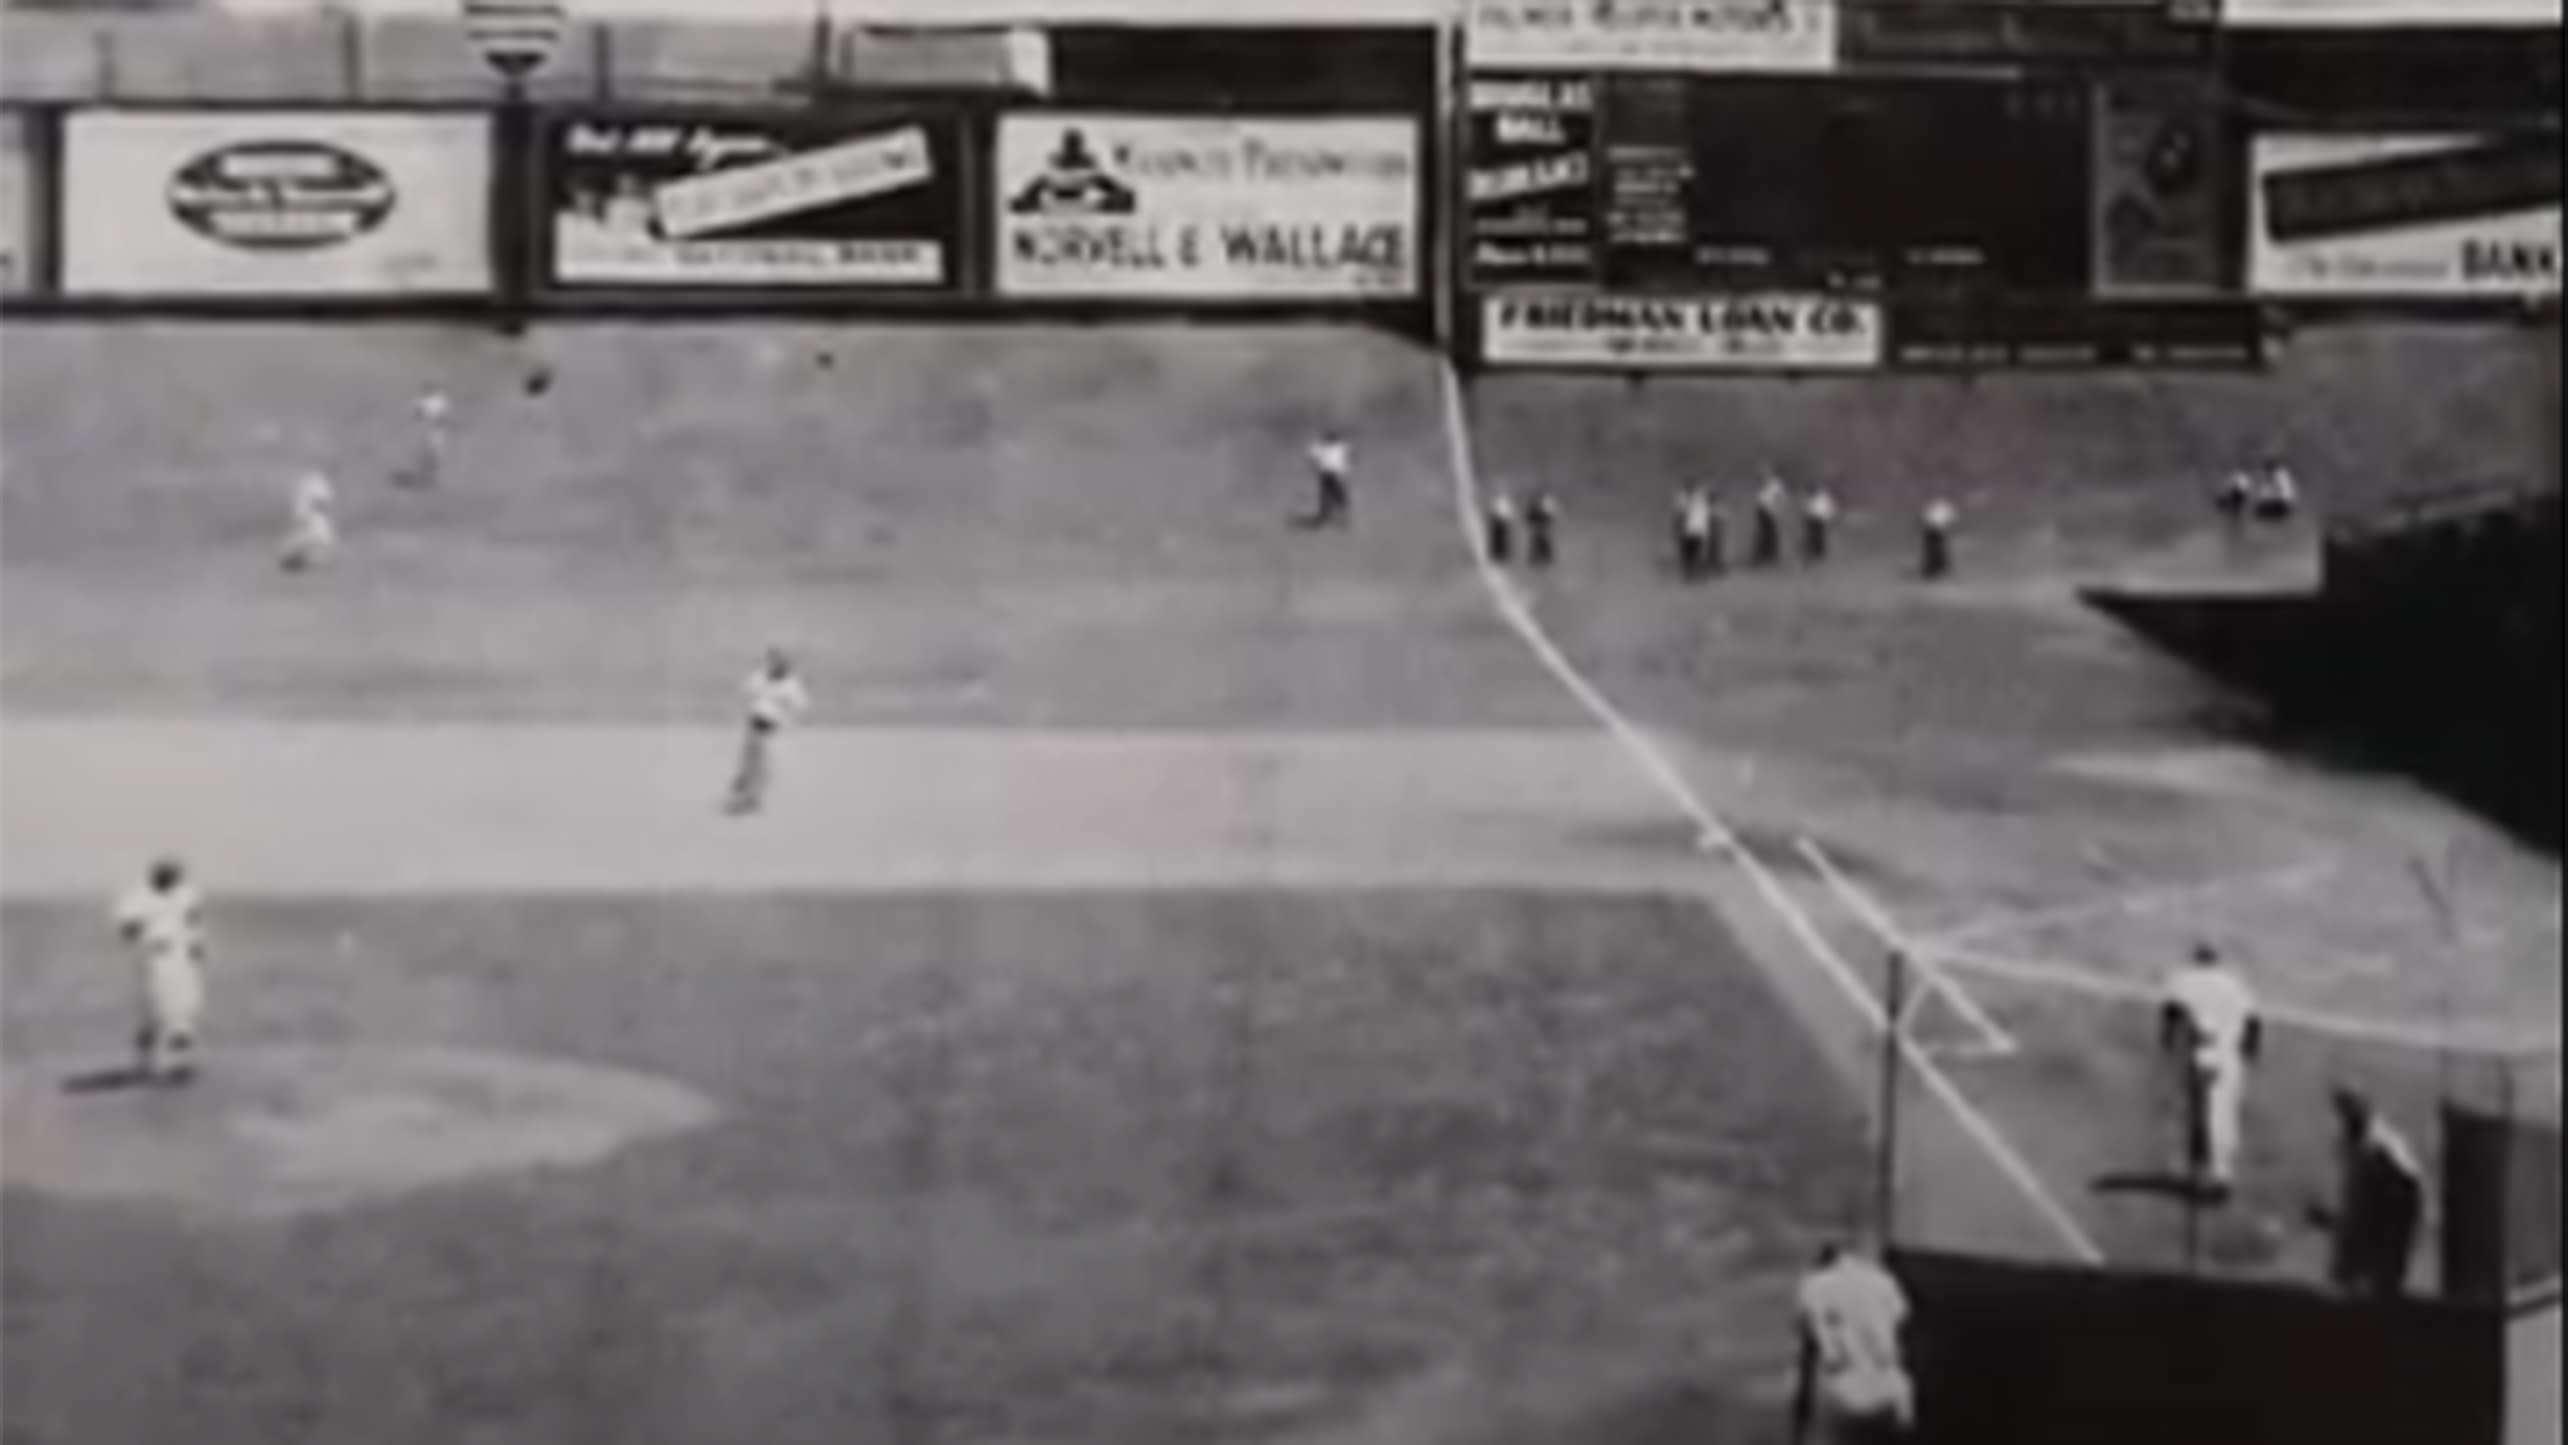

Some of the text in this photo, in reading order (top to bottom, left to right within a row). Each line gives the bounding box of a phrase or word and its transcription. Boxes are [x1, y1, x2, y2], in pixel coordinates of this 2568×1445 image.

[1013, 224, 1166, 270] NORVELL
[1219, 222, 1406, 271] WALLACE
[1499, 302, 1688, 330] FRIEDMAN
[1699, 303, 1799, 334] LOAN
